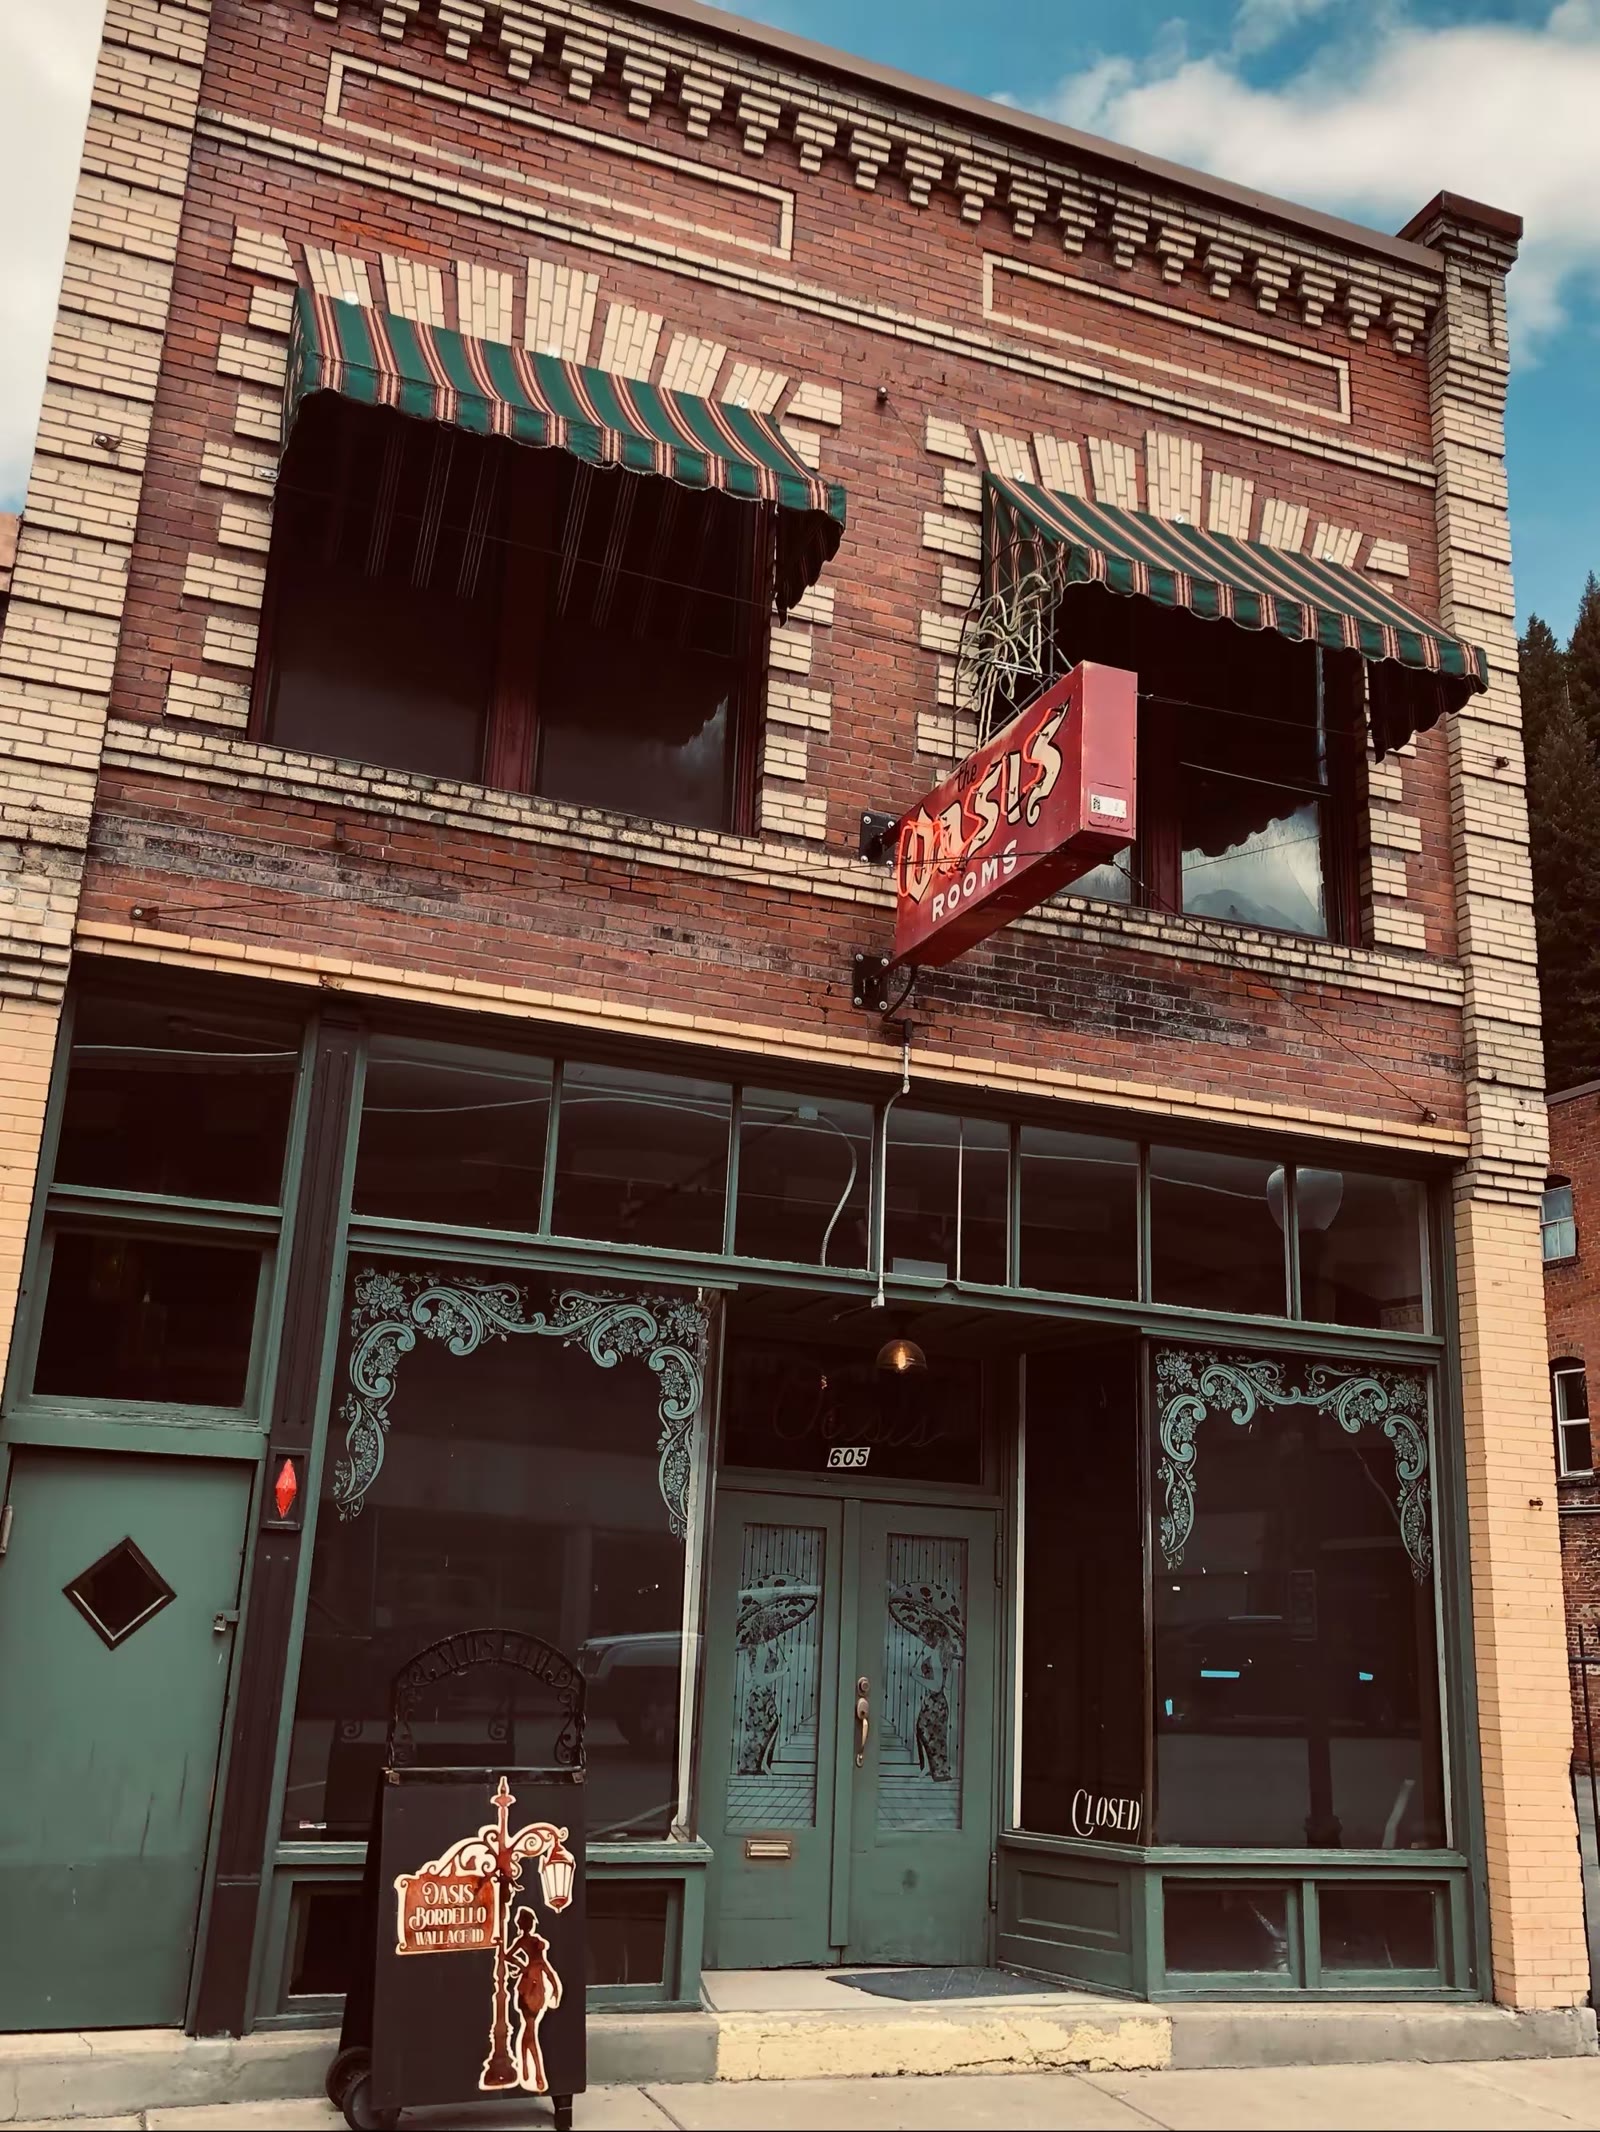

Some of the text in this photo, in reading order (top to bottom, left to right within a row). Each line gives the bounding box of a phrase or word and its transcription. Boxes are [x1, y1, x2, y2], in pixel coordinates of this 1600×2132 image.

[955, 763, 978, 794] the
[932, 838, 1019, 924] ROOMS
[829, 1448, 868, 1467] 605
[421, 1881, 475, 1906] OASIS
[408, 1906, 487, 1931] BORDELLO
[472, 1928, 485, 1944] ID
